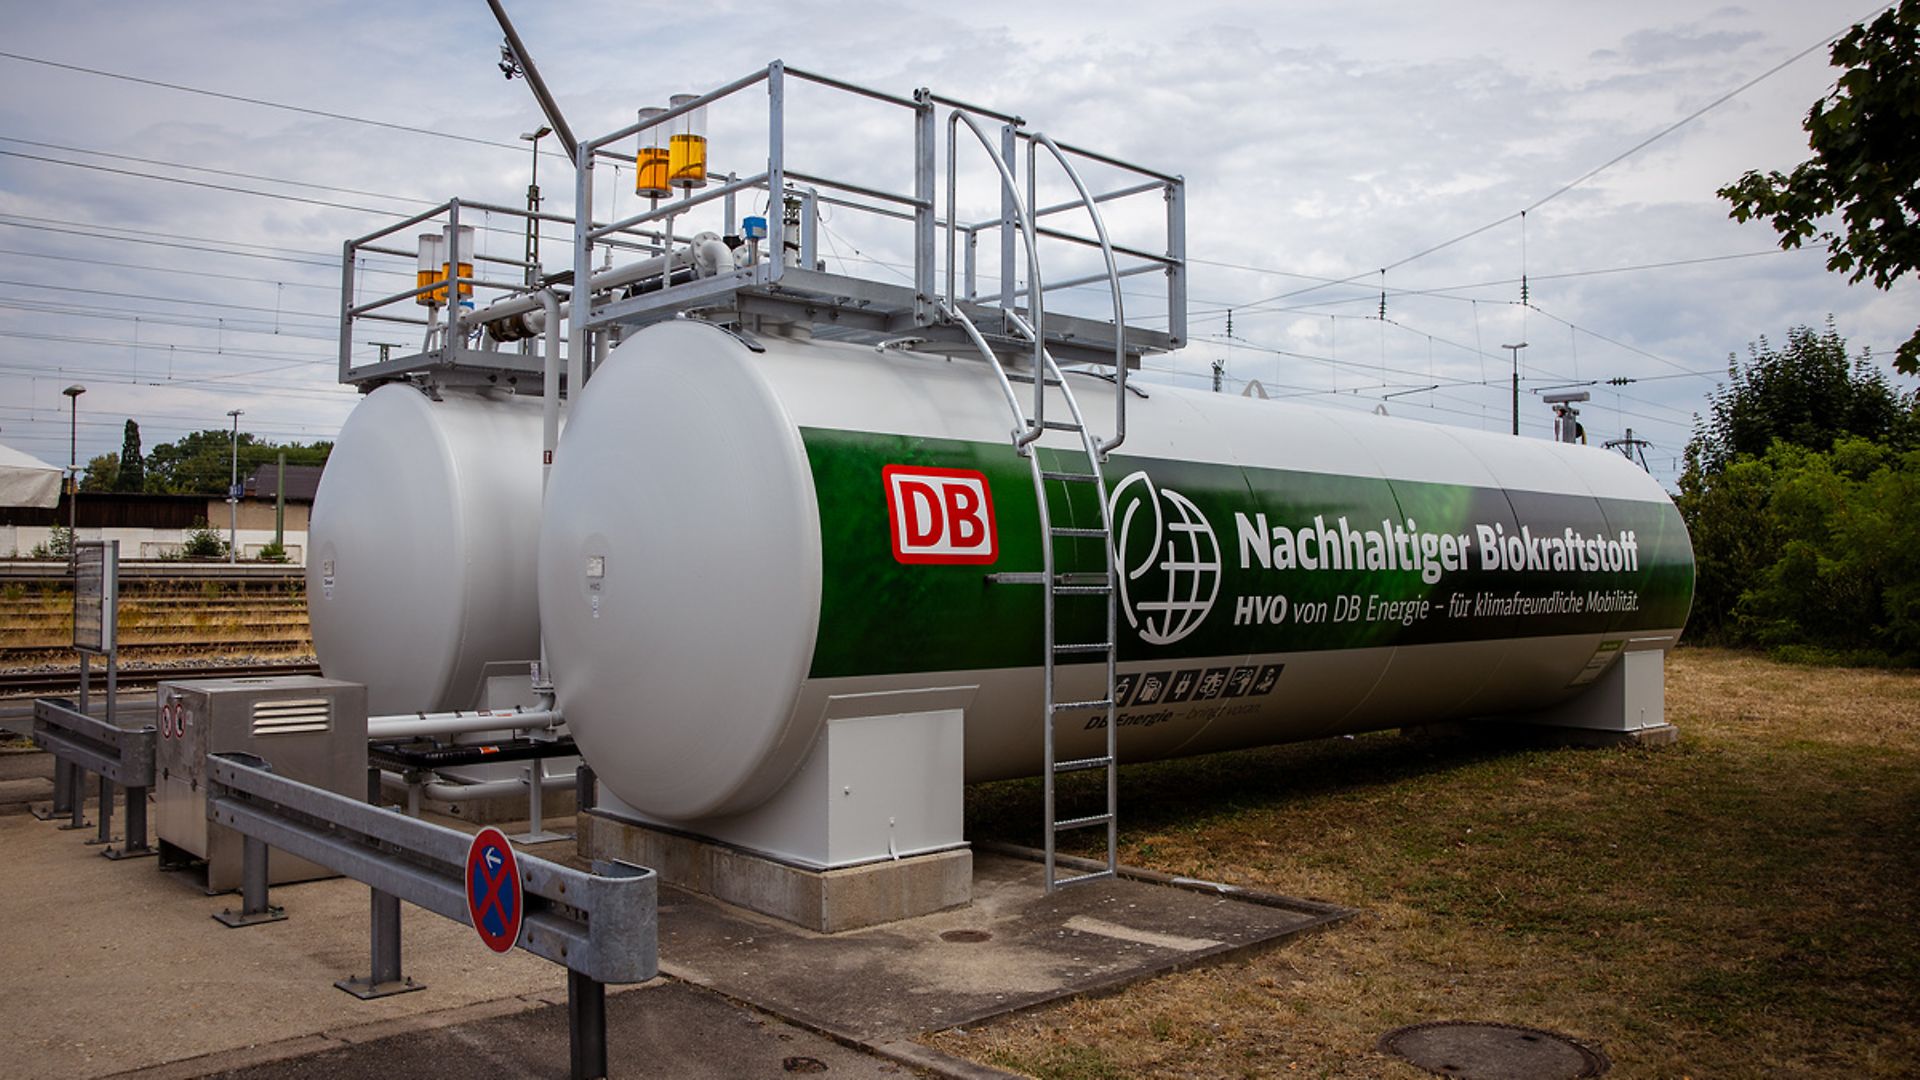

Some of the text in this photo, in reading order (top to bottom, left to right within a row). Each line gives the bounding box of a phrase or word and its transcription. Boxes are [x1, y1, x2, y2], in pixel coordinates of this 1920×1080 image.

[899, 480, 985, 548] DB
[1234, 512, 1638, 584] Nachhaltiger Biokraftstoff
[1233, 594, 1288, 626] HVO
[1293, 602, 1328, 624] von
[1333, 594, 1361, 622] DB
[1366, 593, 1430, 626] Energie
[1448, 592, 1472, 619] für
[1473, 590, 1583, 617] klimafreundliche
[1116, 709, 1173, 727] Energie
